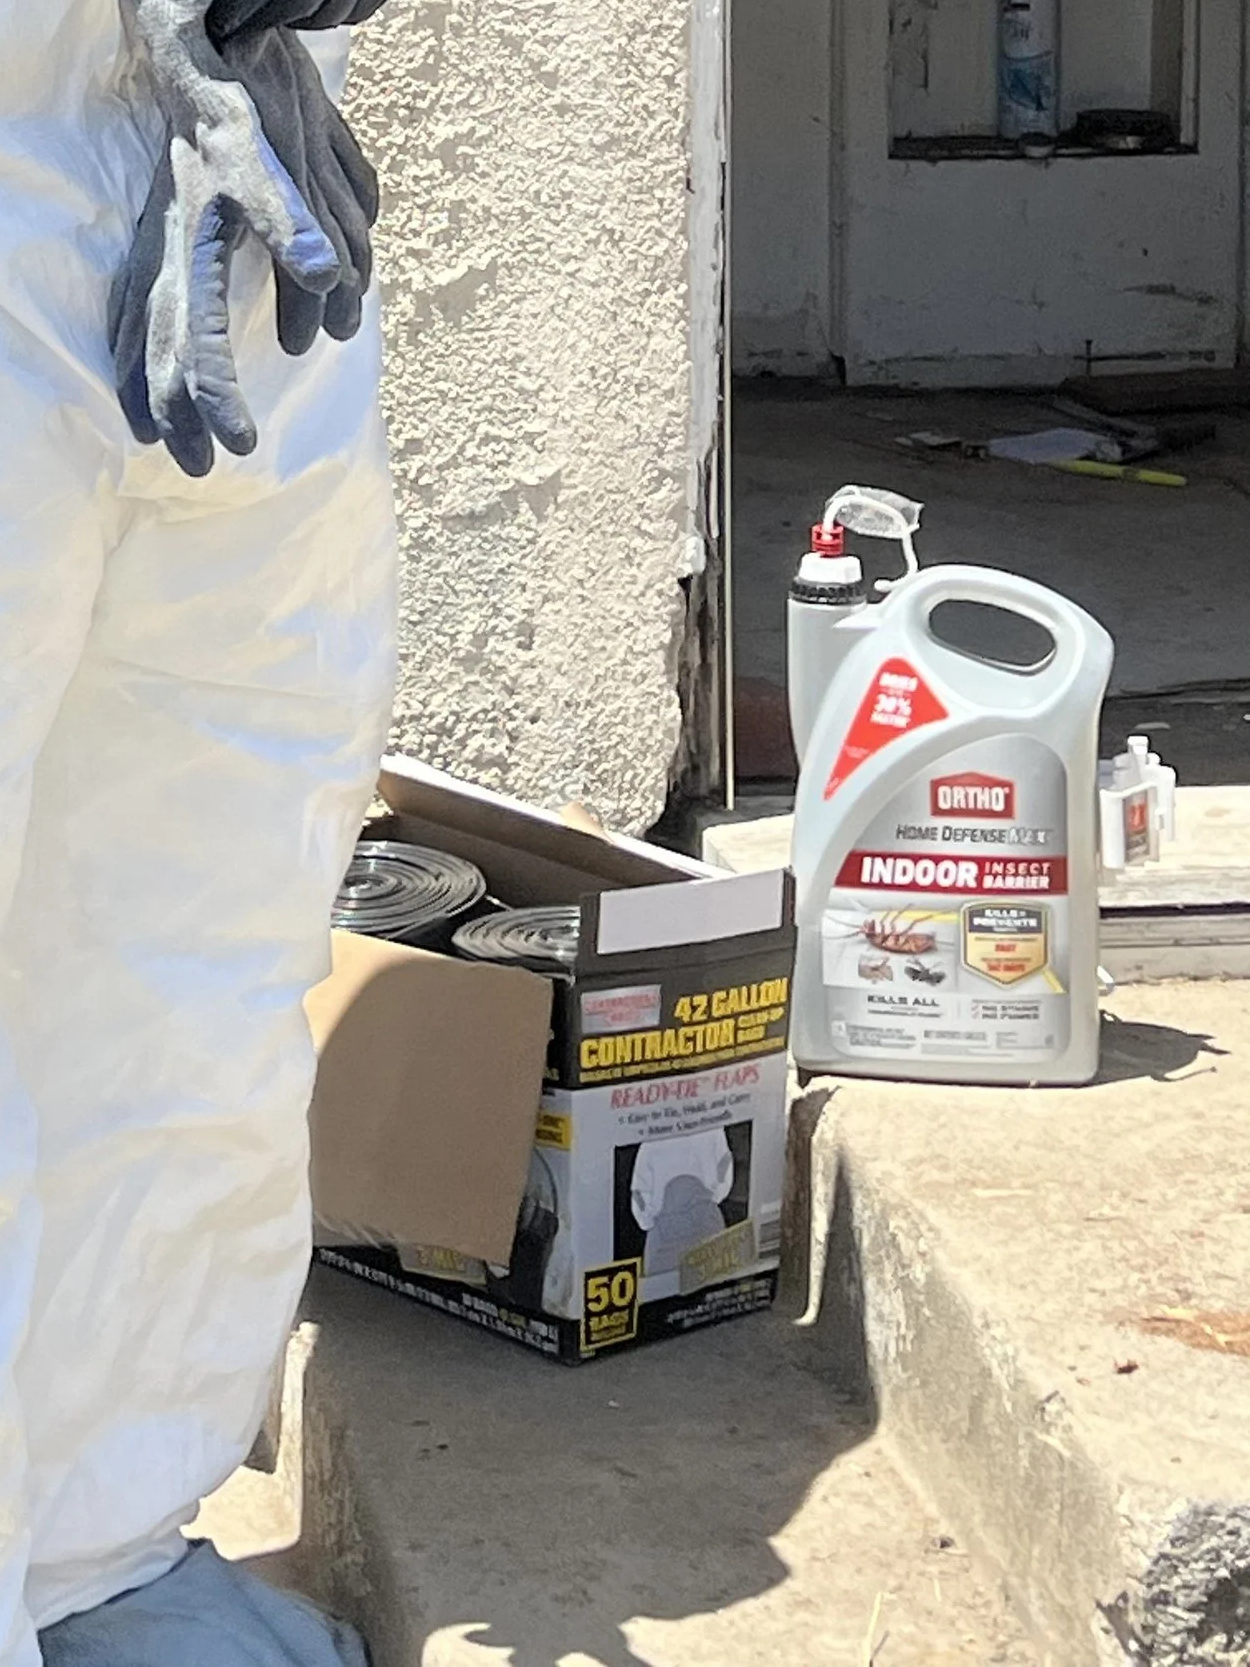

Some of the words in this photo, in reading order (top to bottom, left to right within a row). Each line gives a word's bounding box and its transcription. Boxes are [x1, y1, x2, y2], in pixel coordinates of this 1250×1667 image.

[937, 785, 1005, 811] ORTHO
[896, 824, 938, 841] HOME
[942, 826, 1007, 844] DEFENSE
[860, 856, 978, 888] INDOOR
[984, 862, 1051, 875] INSECT
[983, 875, 1050, 890] BARRIER
[674, 994, 709, 1023] 42
[712, 977, 789, 1019] GALLON
[867, 995, 908, 1005] KILLS
[912, 997, 939, 1007] ALL
[580, 1019, 735, 1070] CONTRACTOR
[715, 1063, 760, 1091] FLAPS
[587, 1271, 635, 1313] 50
